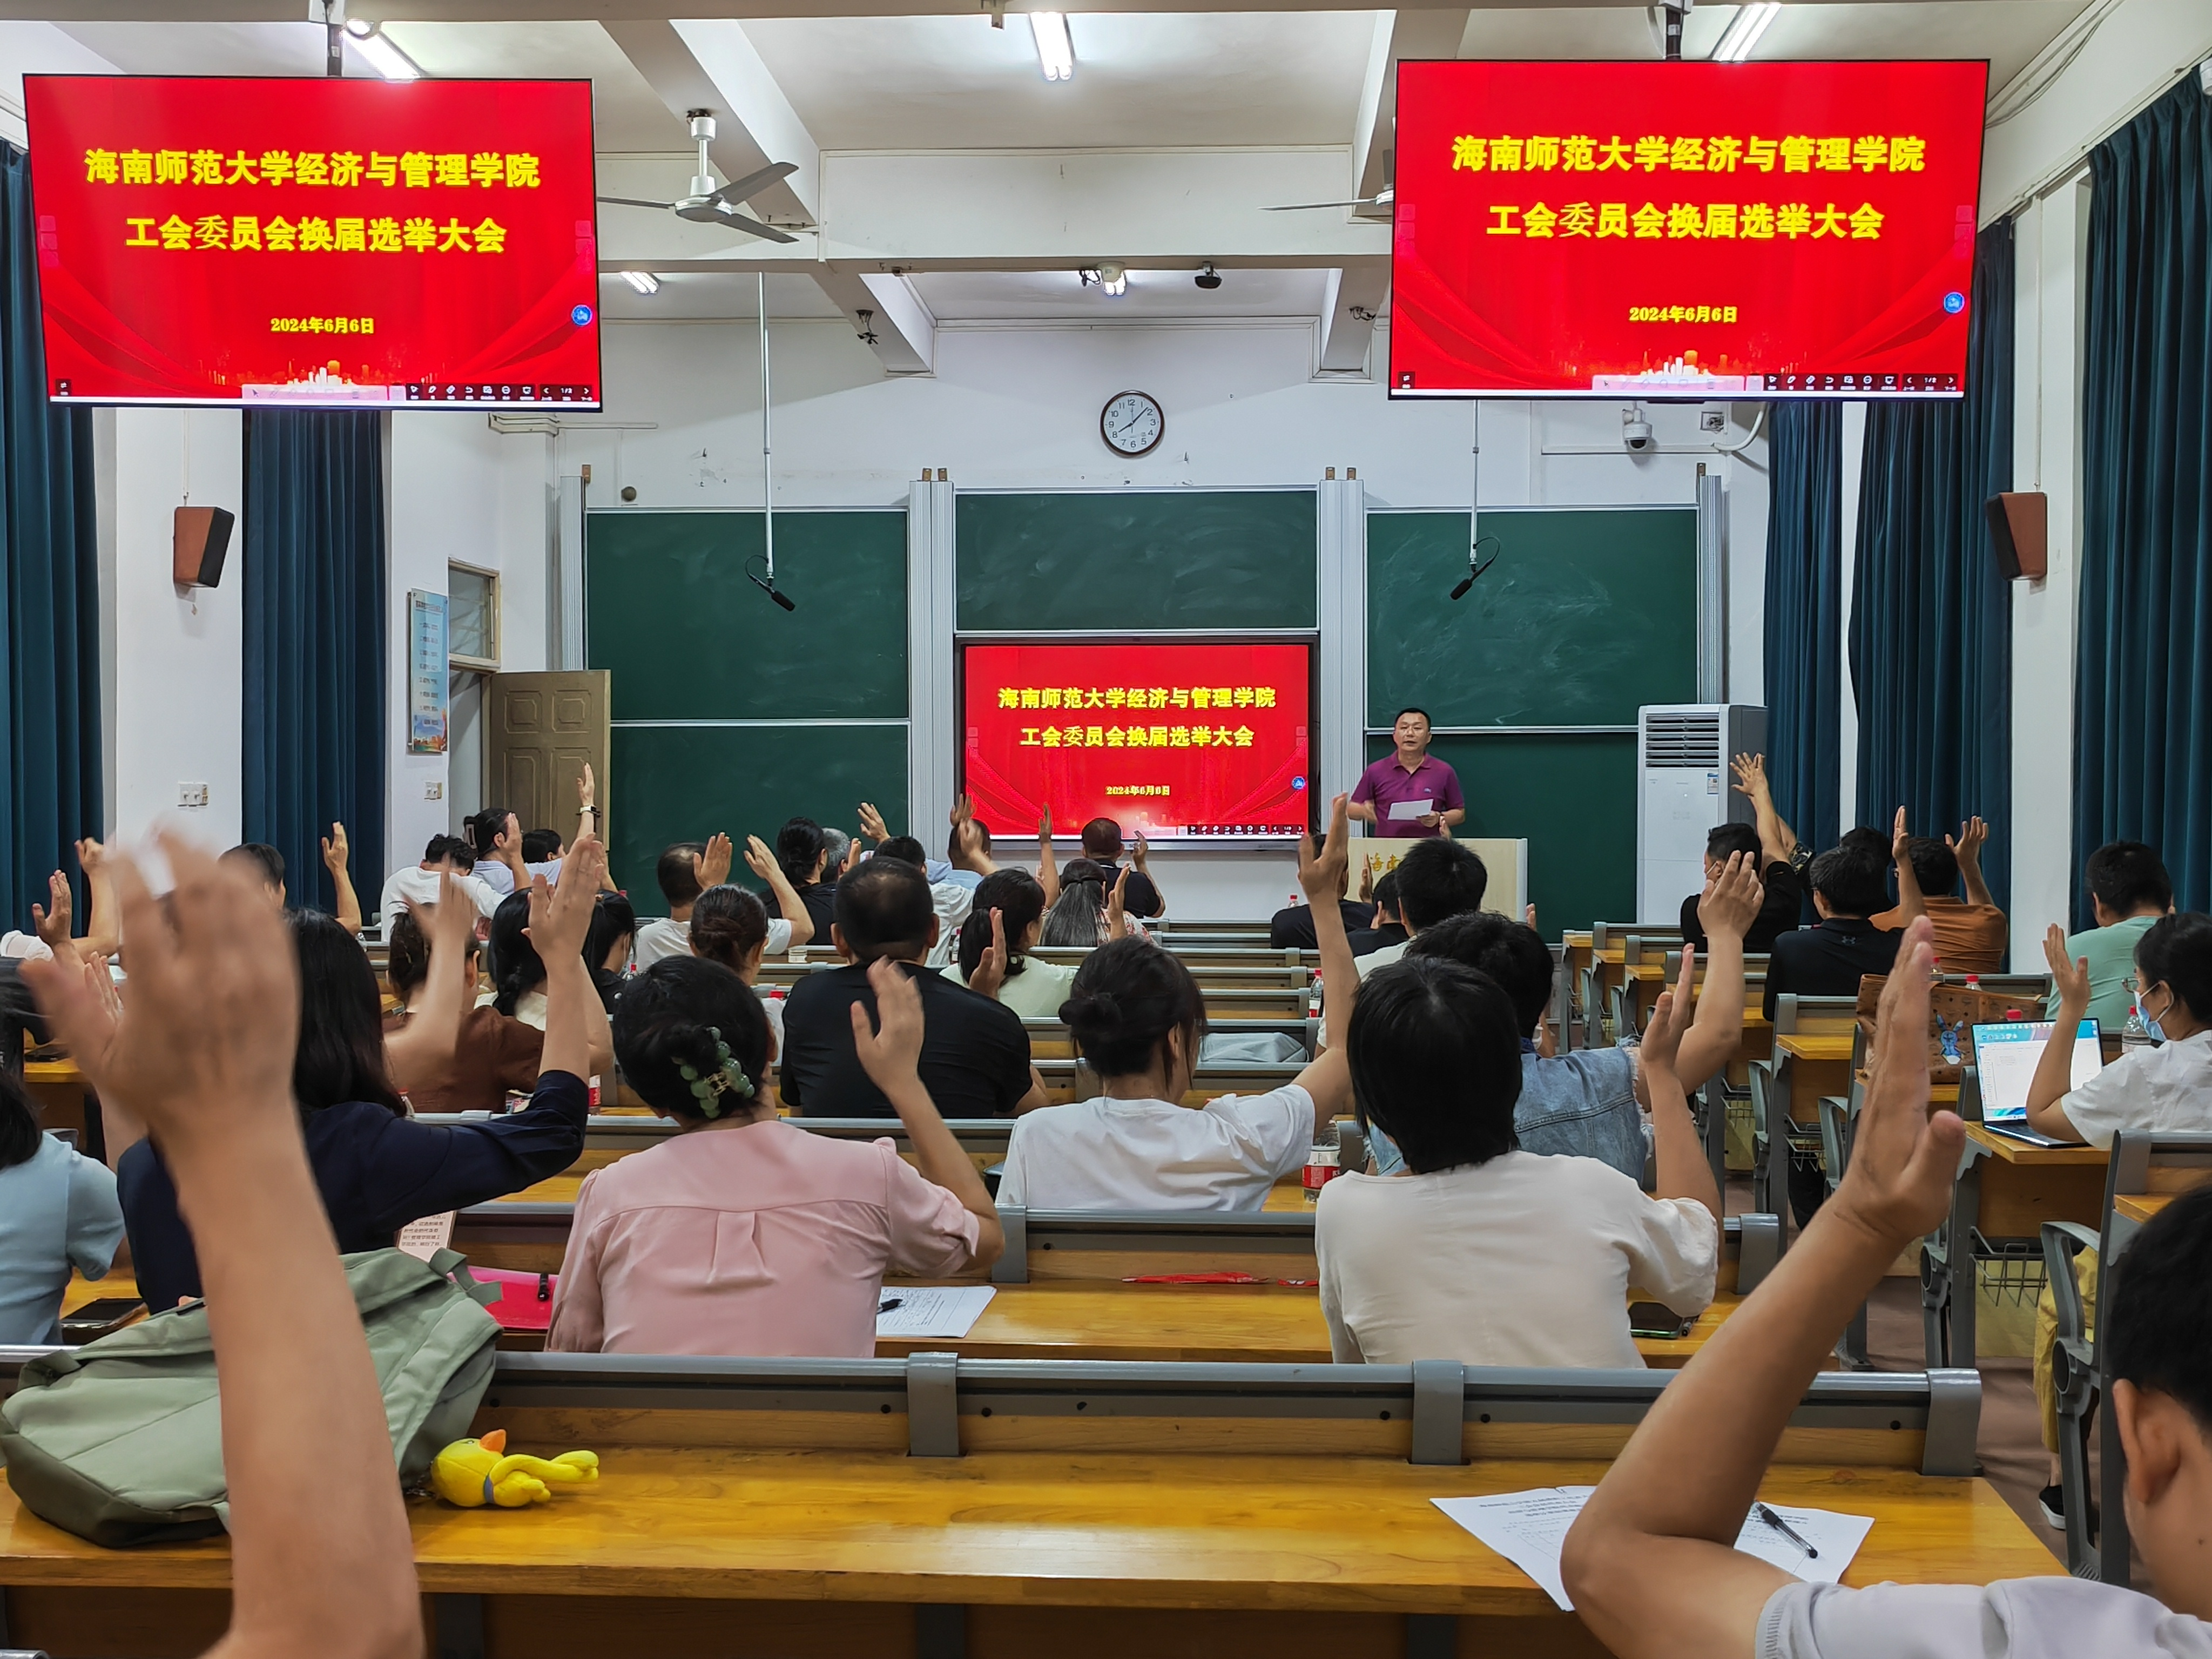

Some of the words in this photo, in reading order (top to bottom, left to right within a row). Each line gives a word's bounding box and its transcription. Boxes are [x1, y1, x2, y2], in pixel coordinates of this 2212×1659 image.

[84, 147, 541, 188] 海南师范大学经济与管理学院
[1451, 134, 1926, 173] 海南师范大学经济与管理学院
[125, 213, 508, 254] 工会委员会换届选举大会
[1486, 201, 1885, 240] 工会委员会换届选举大会
[271, 316, 375, 334] 2024年6月6日
[1628, 305, 1738, 323] 2024年6月6日
[997, 686, 1277, 709] 海南师范大学经济与管理学院
[1019, 725, 1255, 747] 工会委员会换届选举大会
